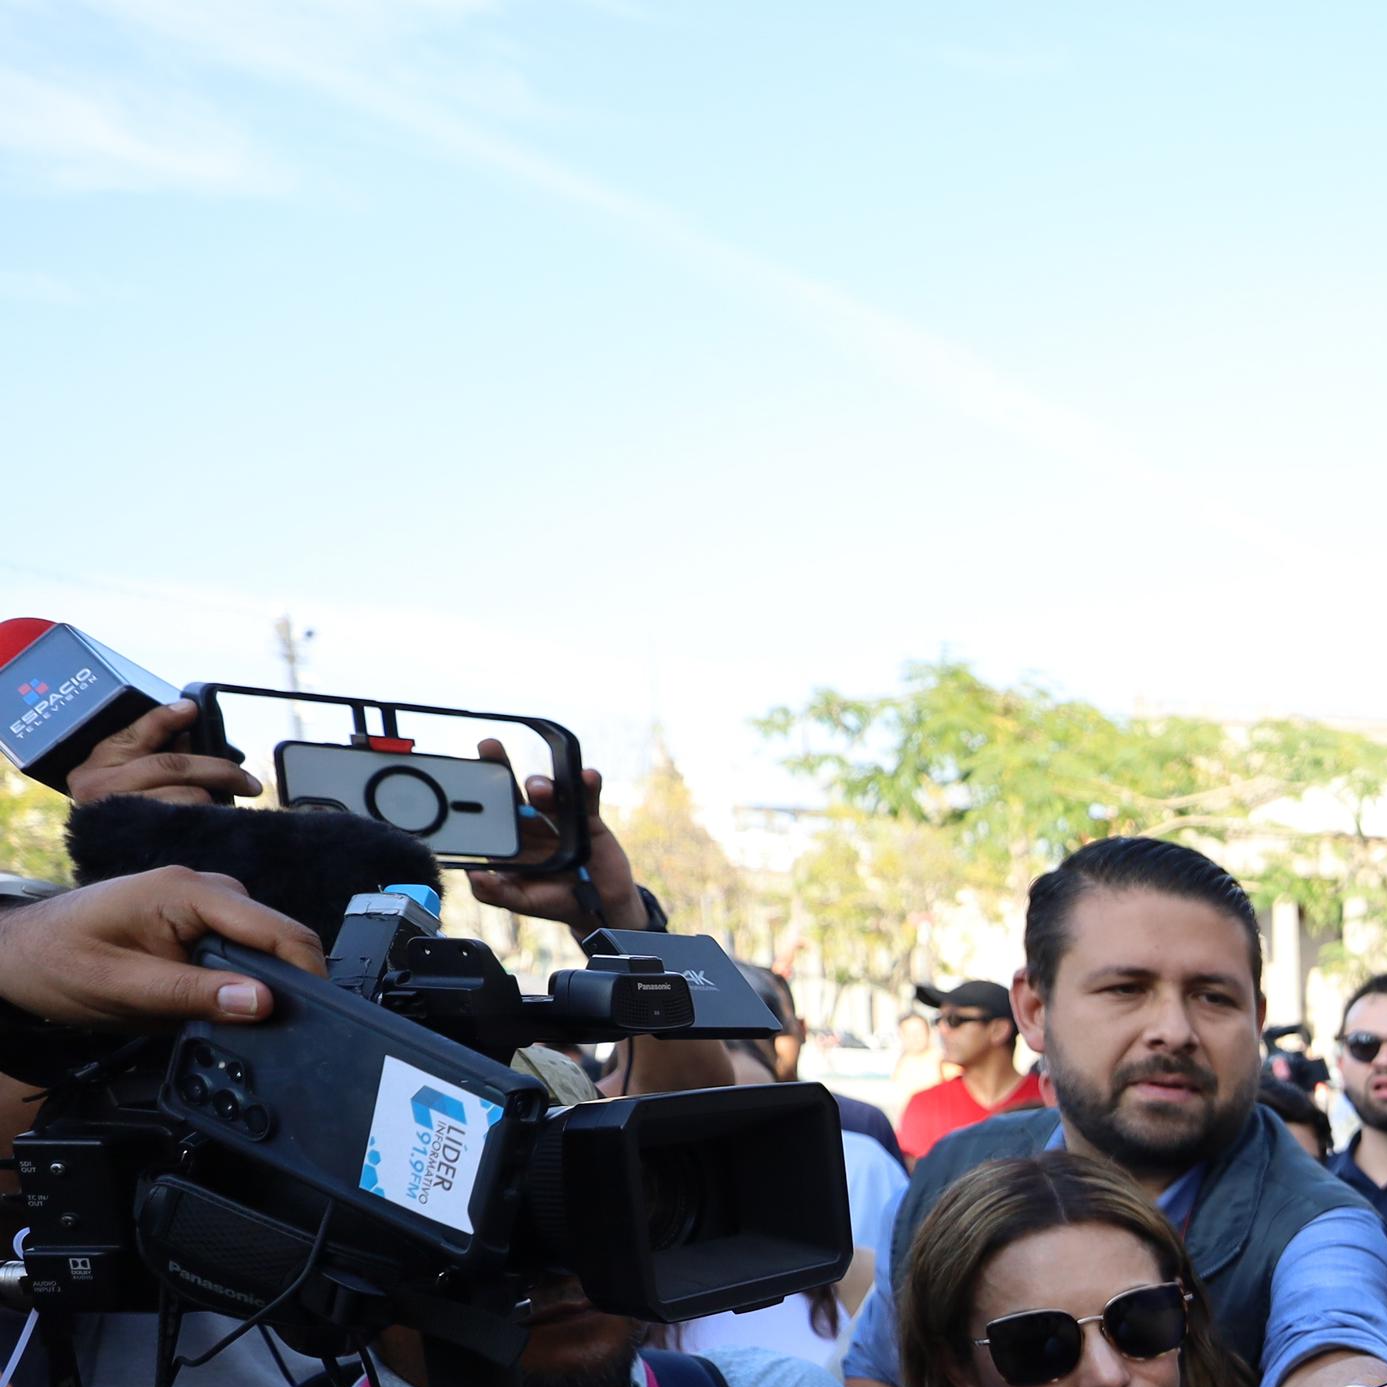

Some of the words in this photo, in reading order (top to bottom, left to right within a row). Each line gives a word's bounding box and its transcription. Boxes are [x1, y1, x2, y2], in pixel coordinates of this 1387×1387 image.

[9, 667, 93, 735] ESPACIO
[637, 982, 672, 991] Panasonic
[20, 1166, 37, 1174] OUT
[406, 1131, 432, 1200] 91.9FM
[418, 1120, 447, 1205] INFORMATIVO
[433, 1125, 468, 1192] LÍDER
[168, 1260, 268, 1309] Panasonic
